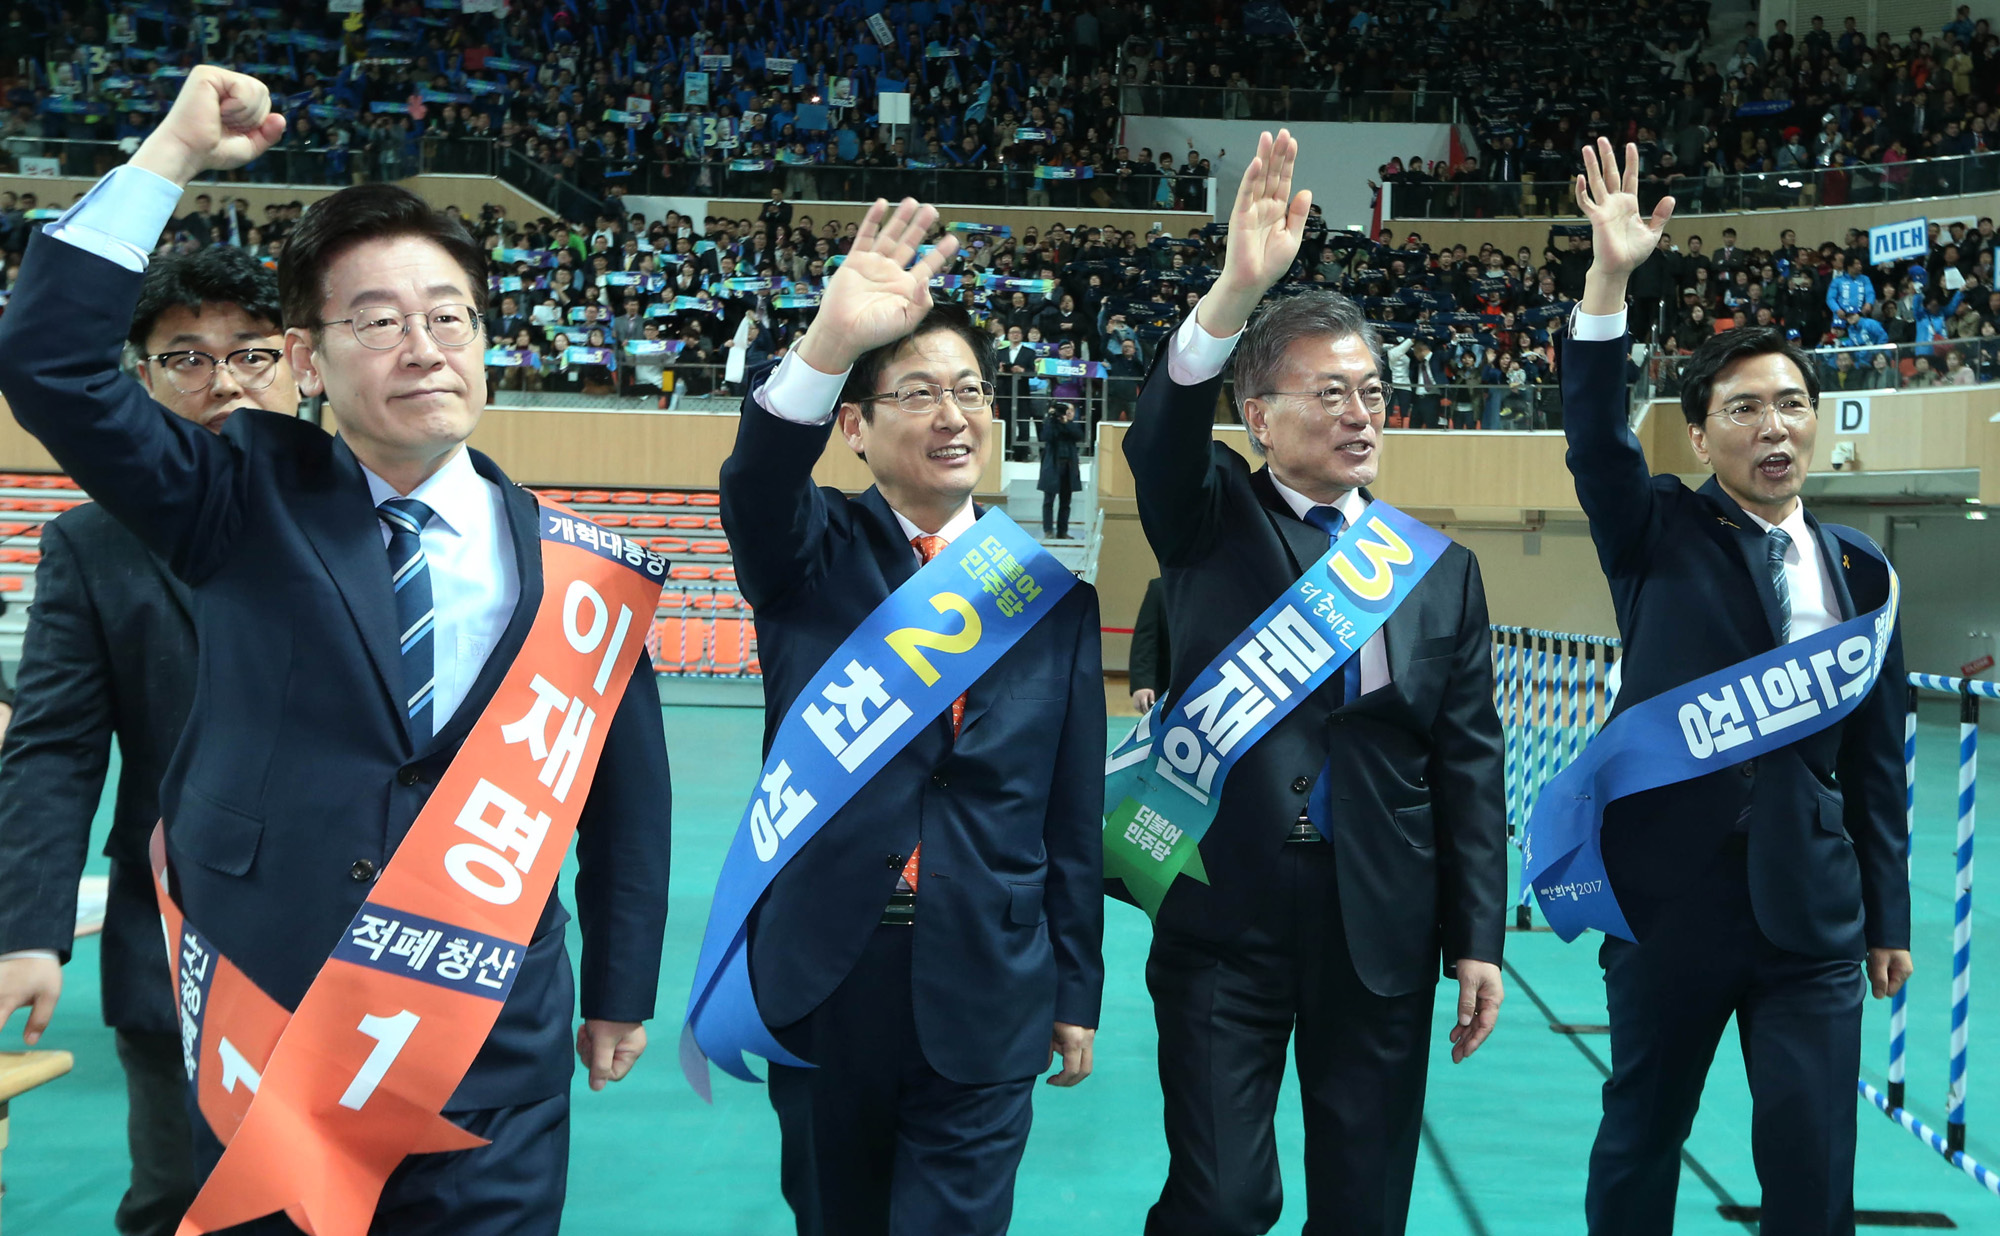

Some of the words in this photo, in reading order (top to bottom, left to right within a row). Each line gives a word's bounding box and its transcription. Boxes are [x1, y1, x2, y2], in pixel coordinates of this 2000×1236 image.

[204, 16, 220, 44] 3
[703, 117, 718, 147] 3
[1841, 400, 1863, 431] D
[959, 549, 1023, 618] 민주당
[979, 535, 1043, 603] 더불어
[1327, 515, 1414, 601] 3
[884, 591, 982, 688] 2
[1300, 581, 1322, 604] 더
[1312, 592, 1356, 652] 준비된
[1155, 603, 1336, 806] 문재인
[1678, 635, 1872, 760] 안희정
[444, 580, 633, 905] 이재명
[1123, 822, 1172, 863] 민주당
[1133, 803, 1184, 846] 더불어
[351, 913, 516, 990] 적폐청산
[338, 1008, 421, 1111] 1
